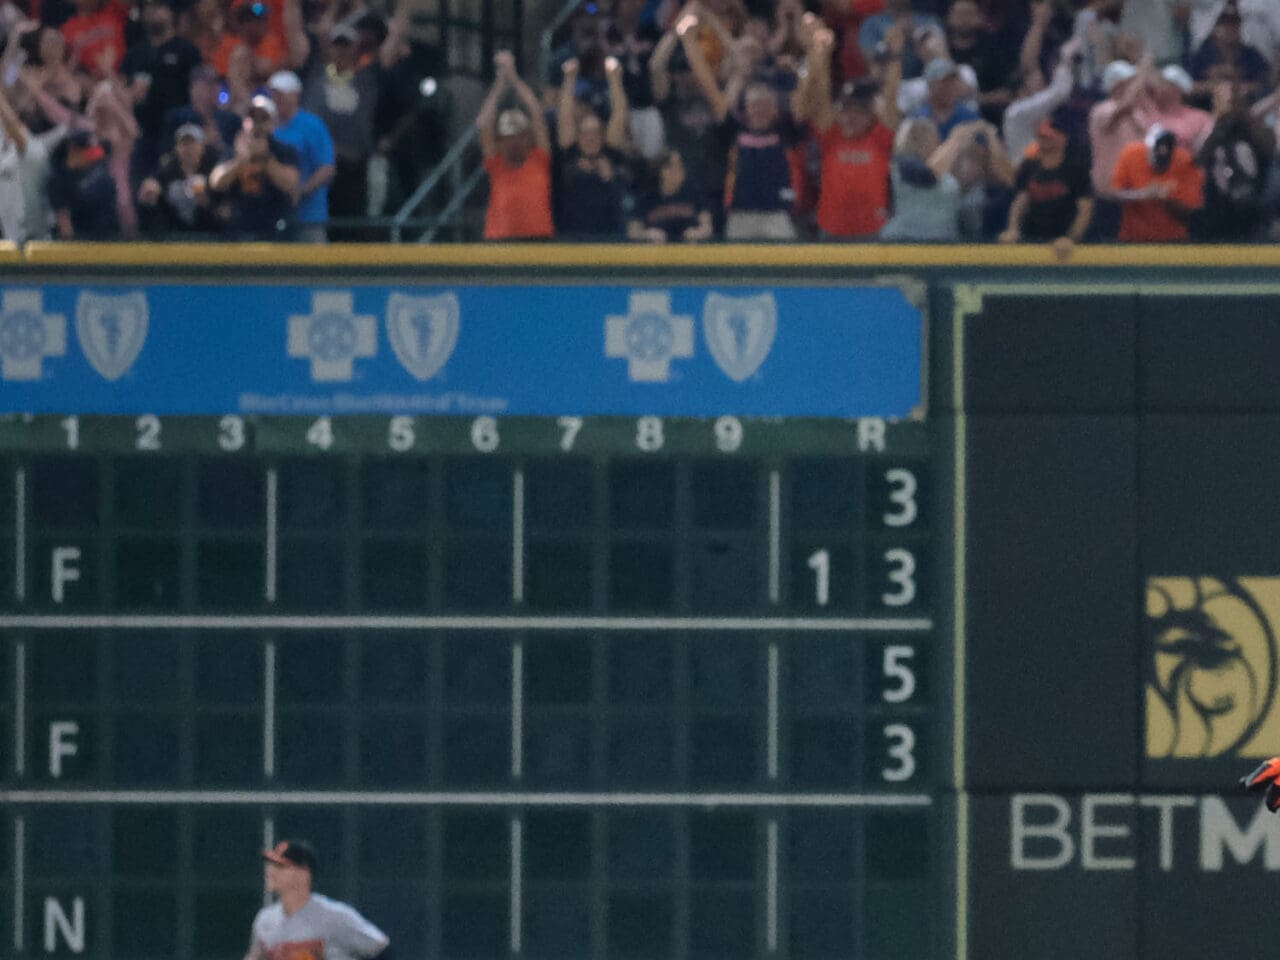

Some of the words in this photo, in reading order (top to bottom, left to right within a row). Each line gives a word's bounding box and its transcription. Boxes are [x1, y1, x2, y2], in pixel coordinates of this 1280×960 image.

[63, 415, 79, 452] 1
[136, 415, 162, 452] 2
[218, 415, 246, 452] 3
[305, 415, 335, 452] 4
[387, 415, 417, 452] 5
[469, 415, 501, 452] 6
[557, 415, 585, 452] 7
[634, 415, 666, 452] 8
[712, 415, 745, 452] 9
[855, 415, 887, 452] R
[883, 468, 917, 527] 3
[52, 546, 81, 602] F
[883, 645, 917, 704] 5
[50, 721, 78, 777] F
[882, 723, 916, 782] 3
[44, 897, 85, 953] N
